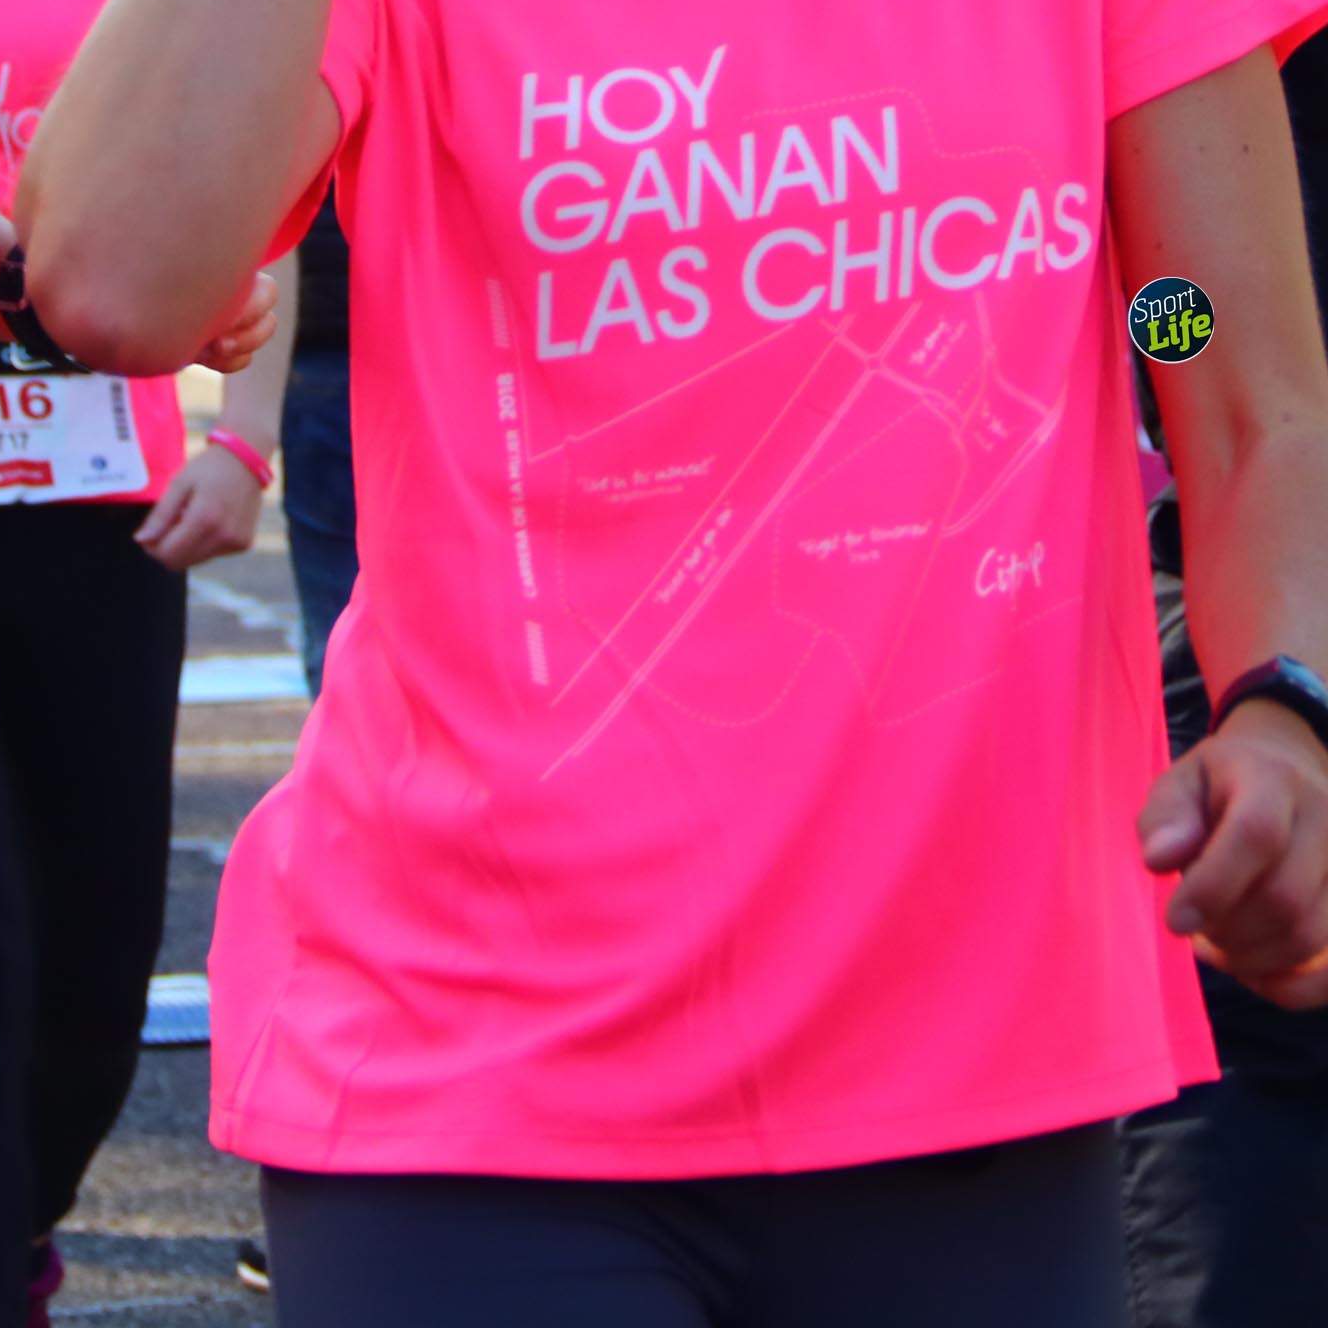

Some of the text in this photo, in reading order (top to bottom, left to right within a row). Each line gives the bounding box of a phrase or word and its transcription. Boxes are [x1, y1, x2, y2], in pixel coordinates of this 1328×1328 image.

[519, 45, 728, 159] HOY
[520, 107, 900, 254] GANAN
[536, 183, 1093, 360] LAS CHICAS
